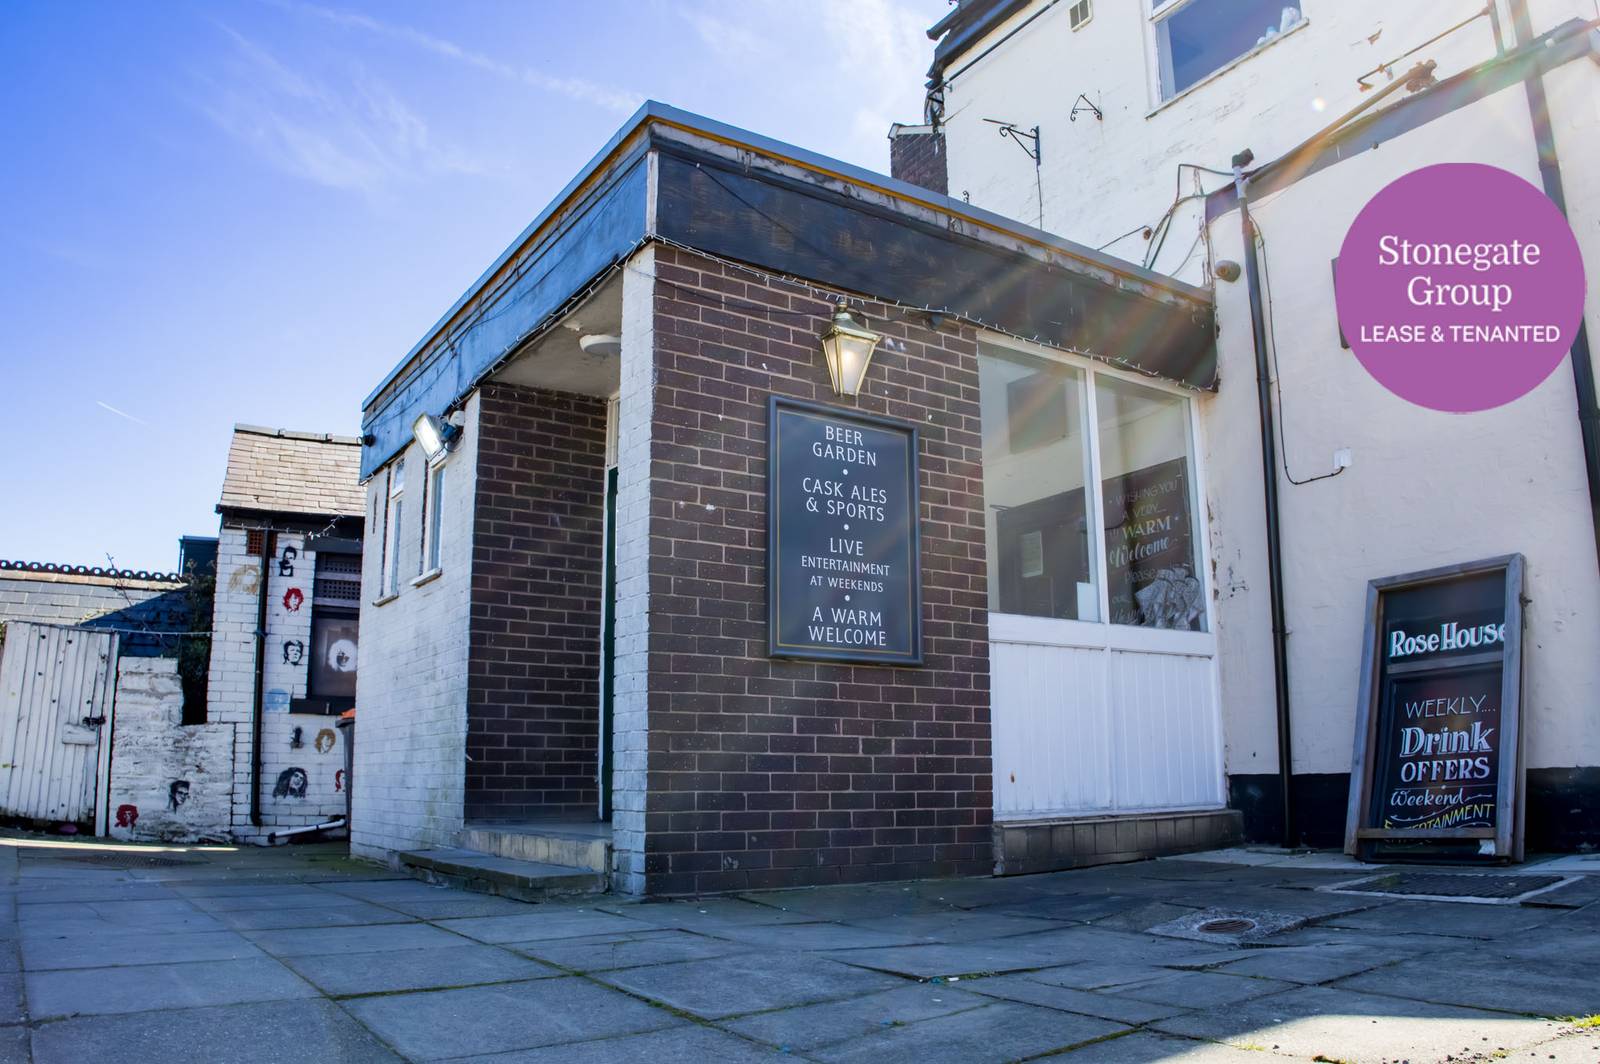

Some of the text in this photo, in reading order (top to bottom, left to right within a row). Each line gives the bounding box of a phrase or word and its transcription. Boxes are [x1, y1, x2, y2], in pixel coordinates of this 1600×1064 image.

[825, 426, 863, 446] BEER
[812, 442, 877, 467] GARDEN
[802, 477, 887, 504] CASK ALES
[806, 498, 885, 522] & SPORTS
[1122, 516, 1172, 539] WARM
[829, 537, 864, 556] LIVE
[1109, 537, 1170, 568] Welcome
[801, 555, 890, 576] ENTERTAINMENT
[810, 576, 884, 593] AT WEEKENDS
[812, 606, 882, 627] A WARM
[808, 625, 887, 646] WELCOME
[1389, 630, 1440, 657] Rose
[1400, 721, 1495, 757] Drink
[1401, 757, 1490, 783] OFFERS
[1390, 787, 1464, 806] Weekend
[1384, 804, 1495, 829] ETAINMENT
